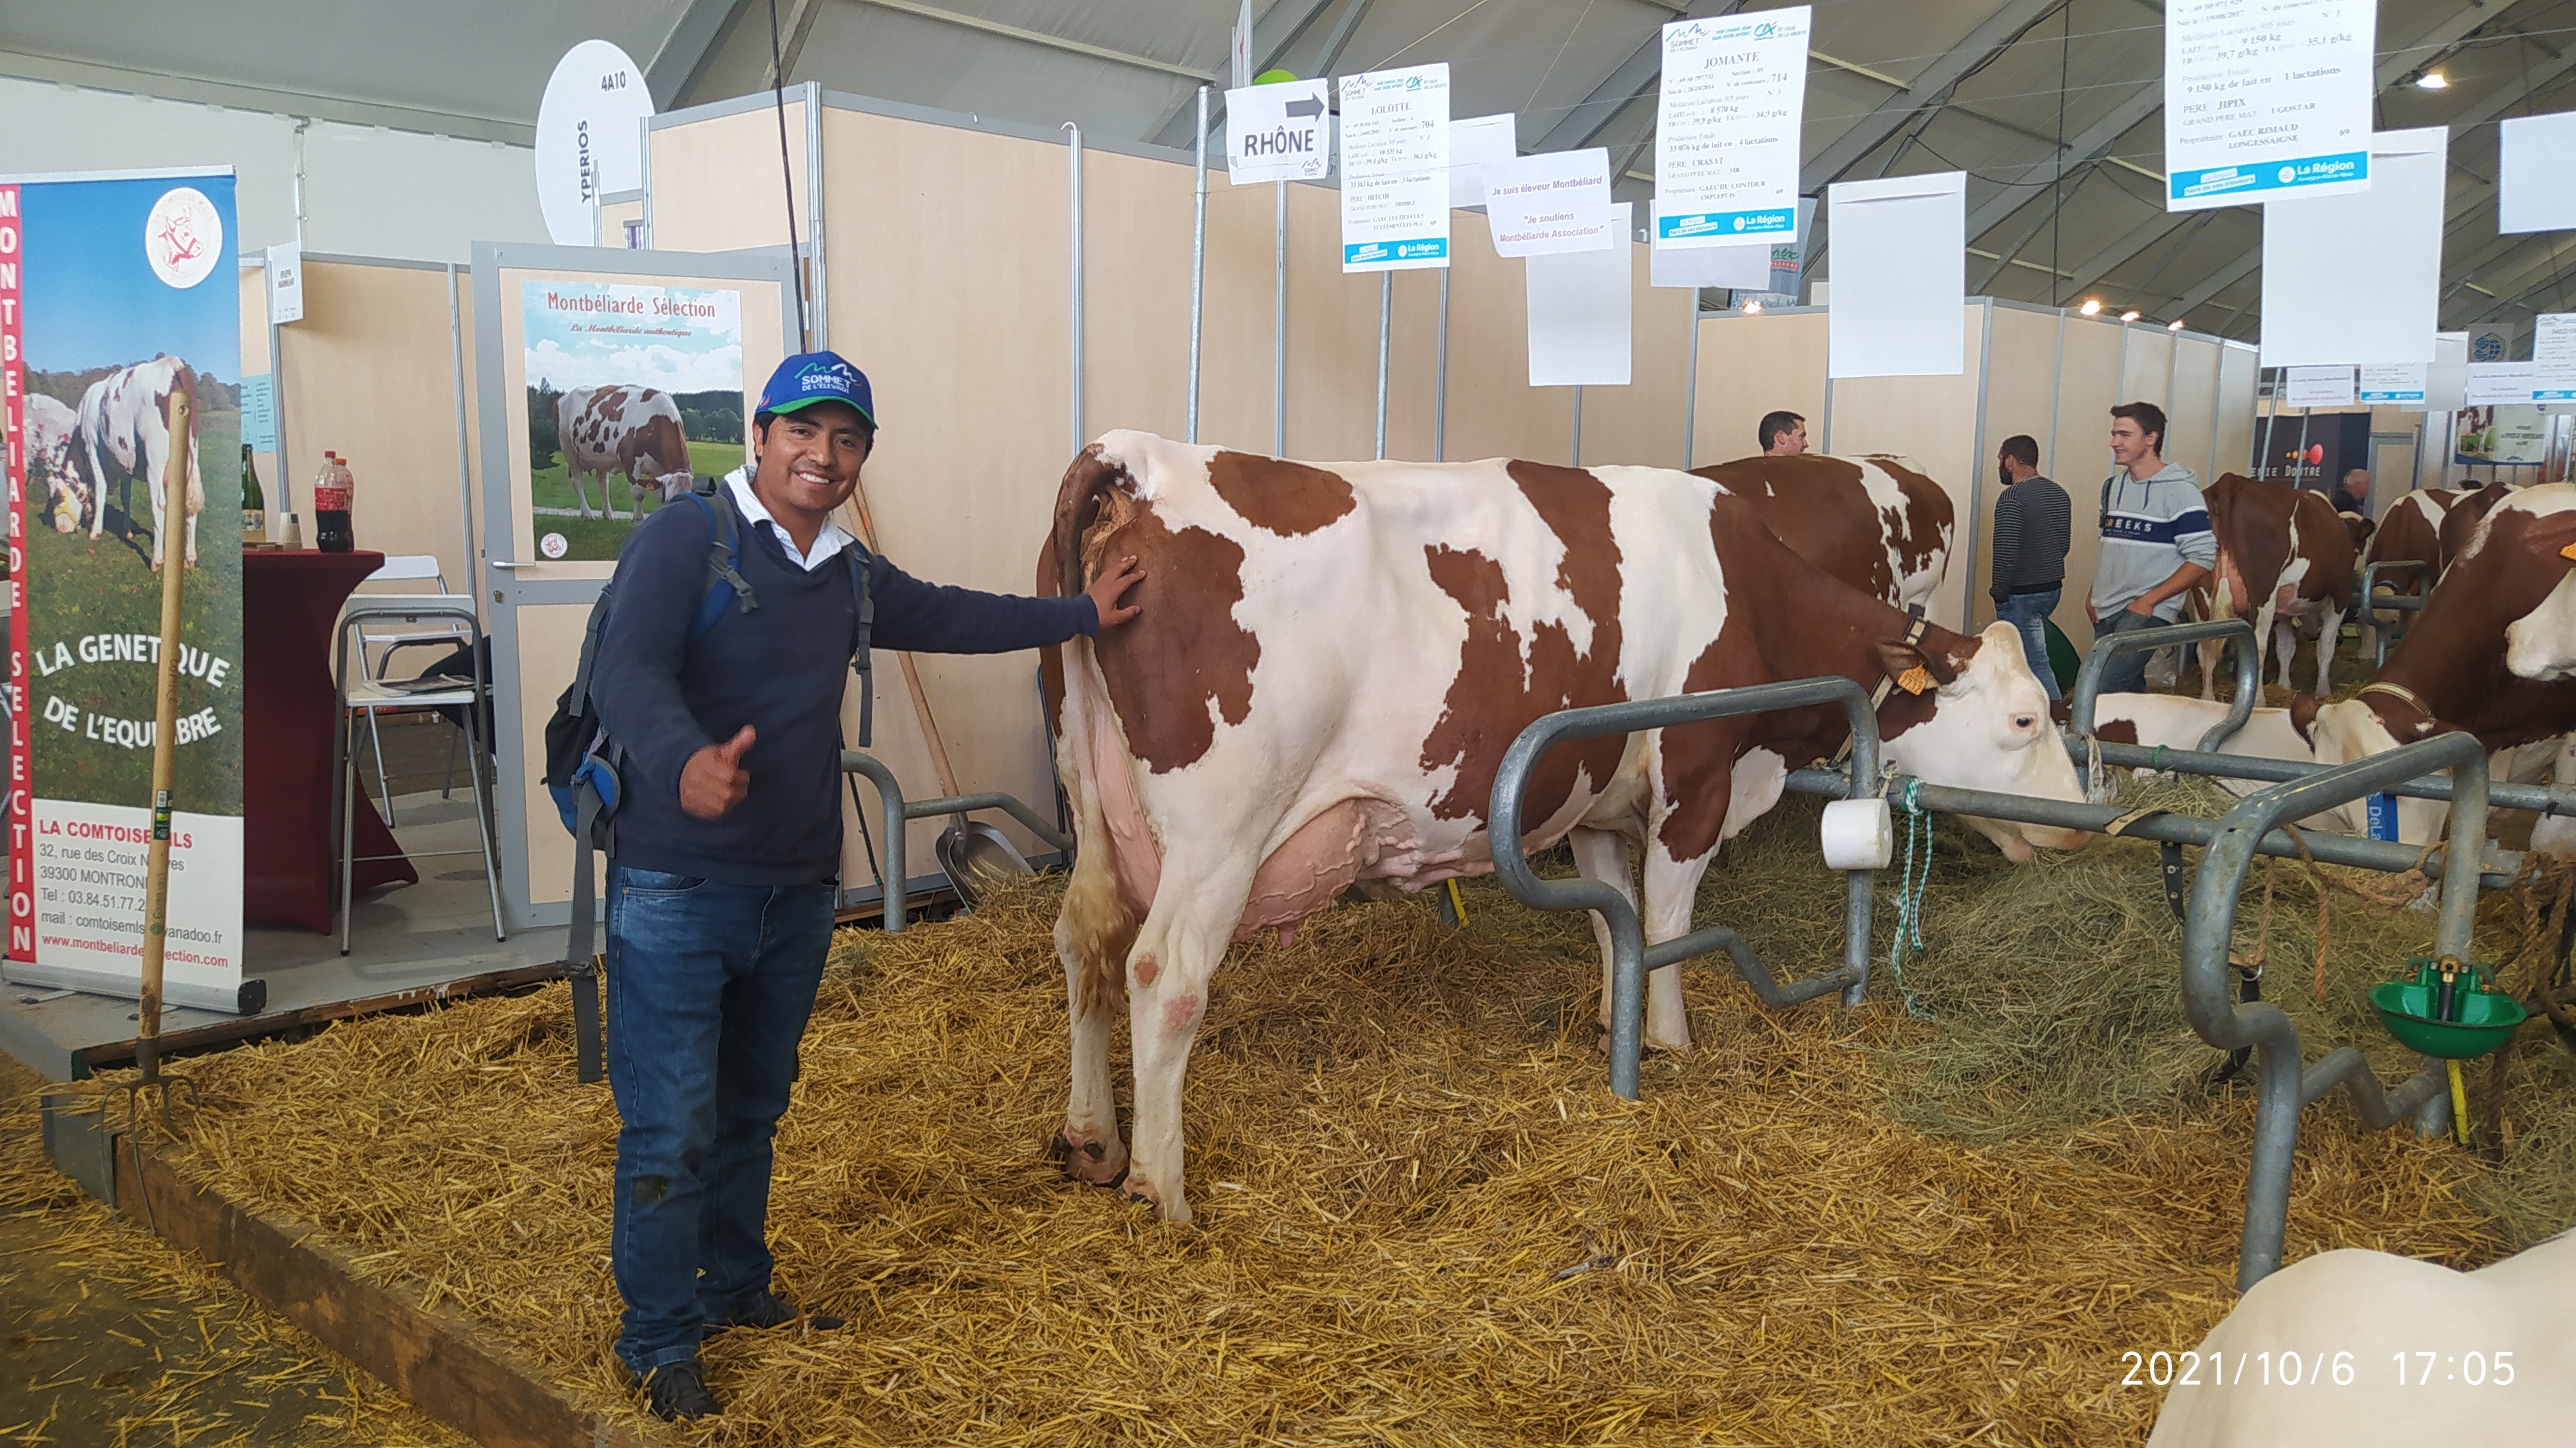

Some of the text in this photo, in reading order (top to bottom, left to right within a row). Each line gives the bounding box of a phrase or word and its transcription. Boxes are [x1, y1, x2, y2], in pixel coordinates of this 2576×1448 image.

[1704, 52, 1760, 69] JOMANTE
[601, 70, 627, 92] 4A10
[1770, 72, 1788, 82] 714
[2213, 82, 2226, 91] kg
[2228, 80, 2239, 89] de
[2242, 78, 2257, 88] lait
[2292, 66, 2342, 80] lactations
[1371, 102, 1411, 115] LOLOTTE
[2217, 98, 2246, 111] JIPIX
[1244, 125, 1314, 157] RHÔNE
[2228, 128, 2255, 139] GAEC
[1692, 143, 1700, 151] kg
[1745, 137, 1779, 146] lactations
[577, 120, 592, 205] YPERIOS
[2297, 161, 2354, 176] La Région
[1492, 175, 1603, 196] Je suis éleveur Montbéliard
[1730, 181, 1766, 189] CONTOUR
[1539, 212, 1575, 224] soutiens
[1746, 214, 1786, 226] La Région
[1499, 229, 1549, 243] Montbéliarde
[1417, 242, 1440, 253] Région
[547, 292, 715, 318] Montbéliarde Sélection
[802, 375, 851, 388] SOMMET
[35, 633, 231, 689] LA GENETQUE
[44, 695, 223, 750] DE L'EQUIBRE
[10, 651, 31, 952] SELECTION
[39, 819, 61, 835] LA
[67, 821, 152, 844] COMTOISE
[39, 843, 58, 859] 32,
[61, 847, 81, 861] rue
[84, 848, 104, 863] des
[107, 850, 137, 866] Croix
[40, 865, 149, 890] 39300 MONTRON
[41, 887, 58, 902] Tel
[68, 890, 146, 912] 03.84.51.77.2
[41, 911, 65, 926] mail
